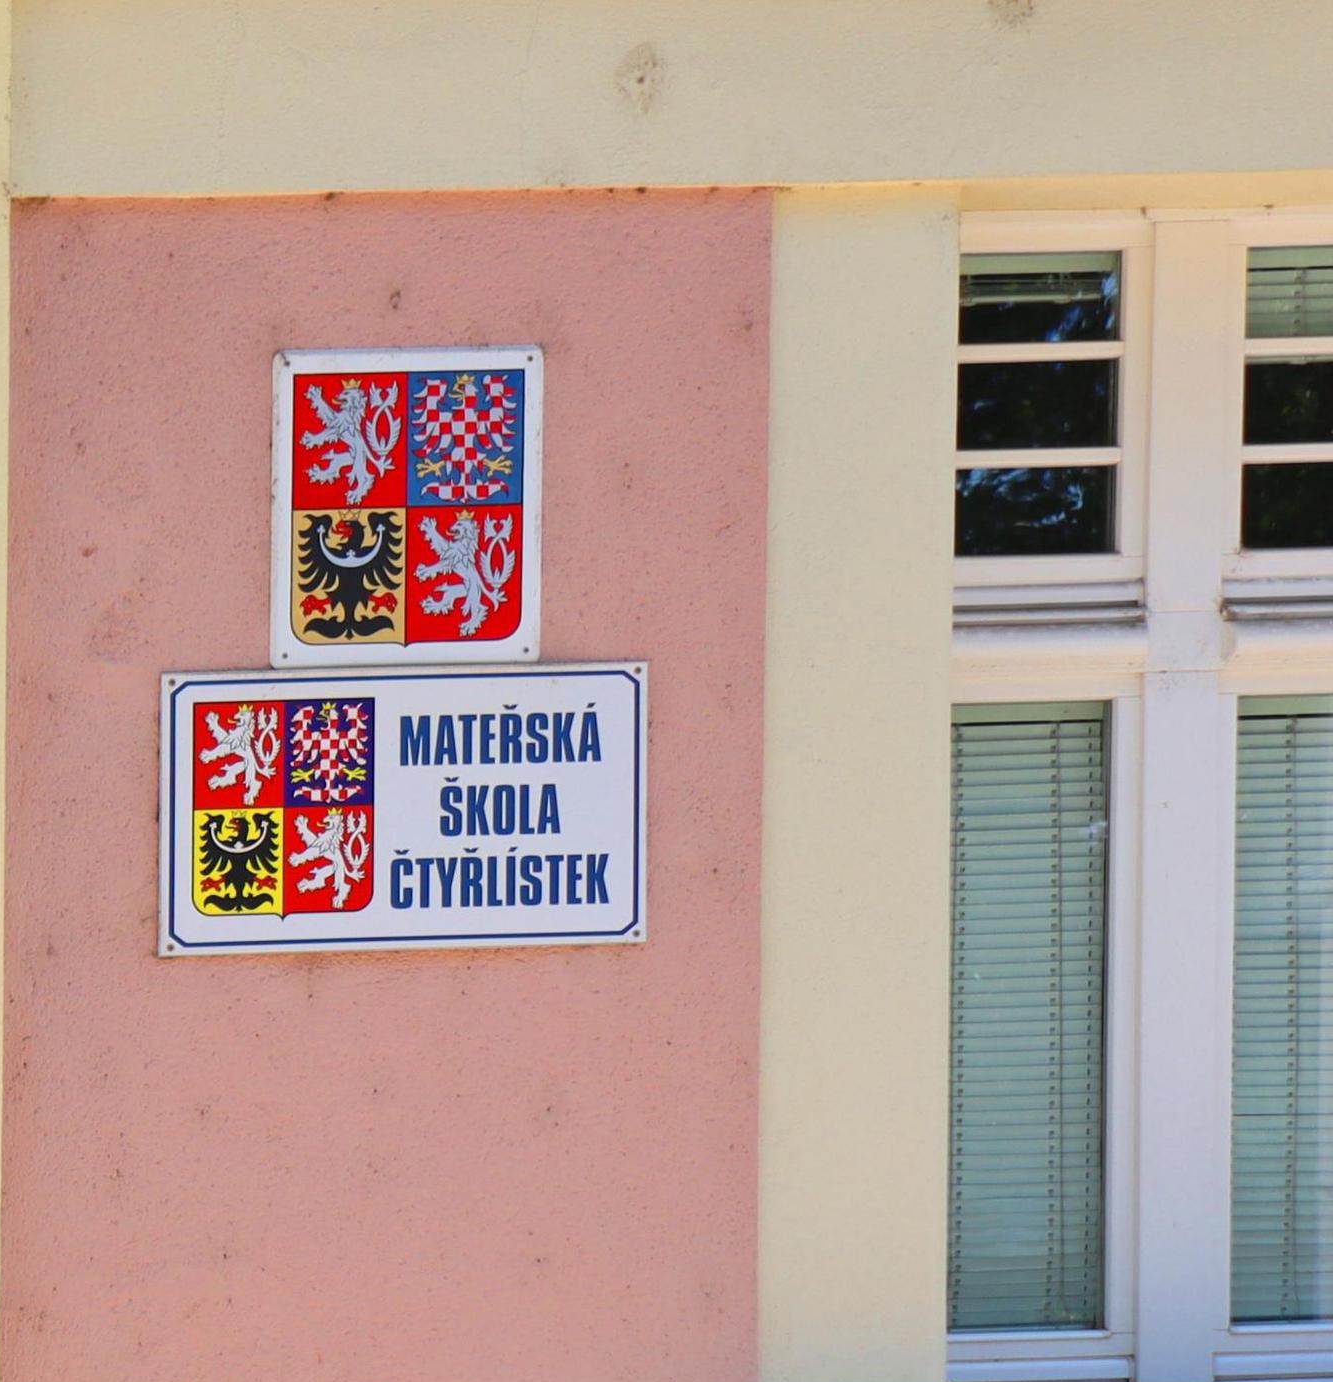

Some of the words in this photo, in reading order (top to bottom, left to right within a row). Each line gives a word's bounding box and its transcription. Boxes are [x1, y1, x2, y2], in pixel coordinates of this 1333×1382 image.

[399, 703, 602, 767] MATEŘSKÁ
[439, 777, 562, 837] ŠKOLA
[389, 847, 611, 910] ČTYŘLÍSTEK
